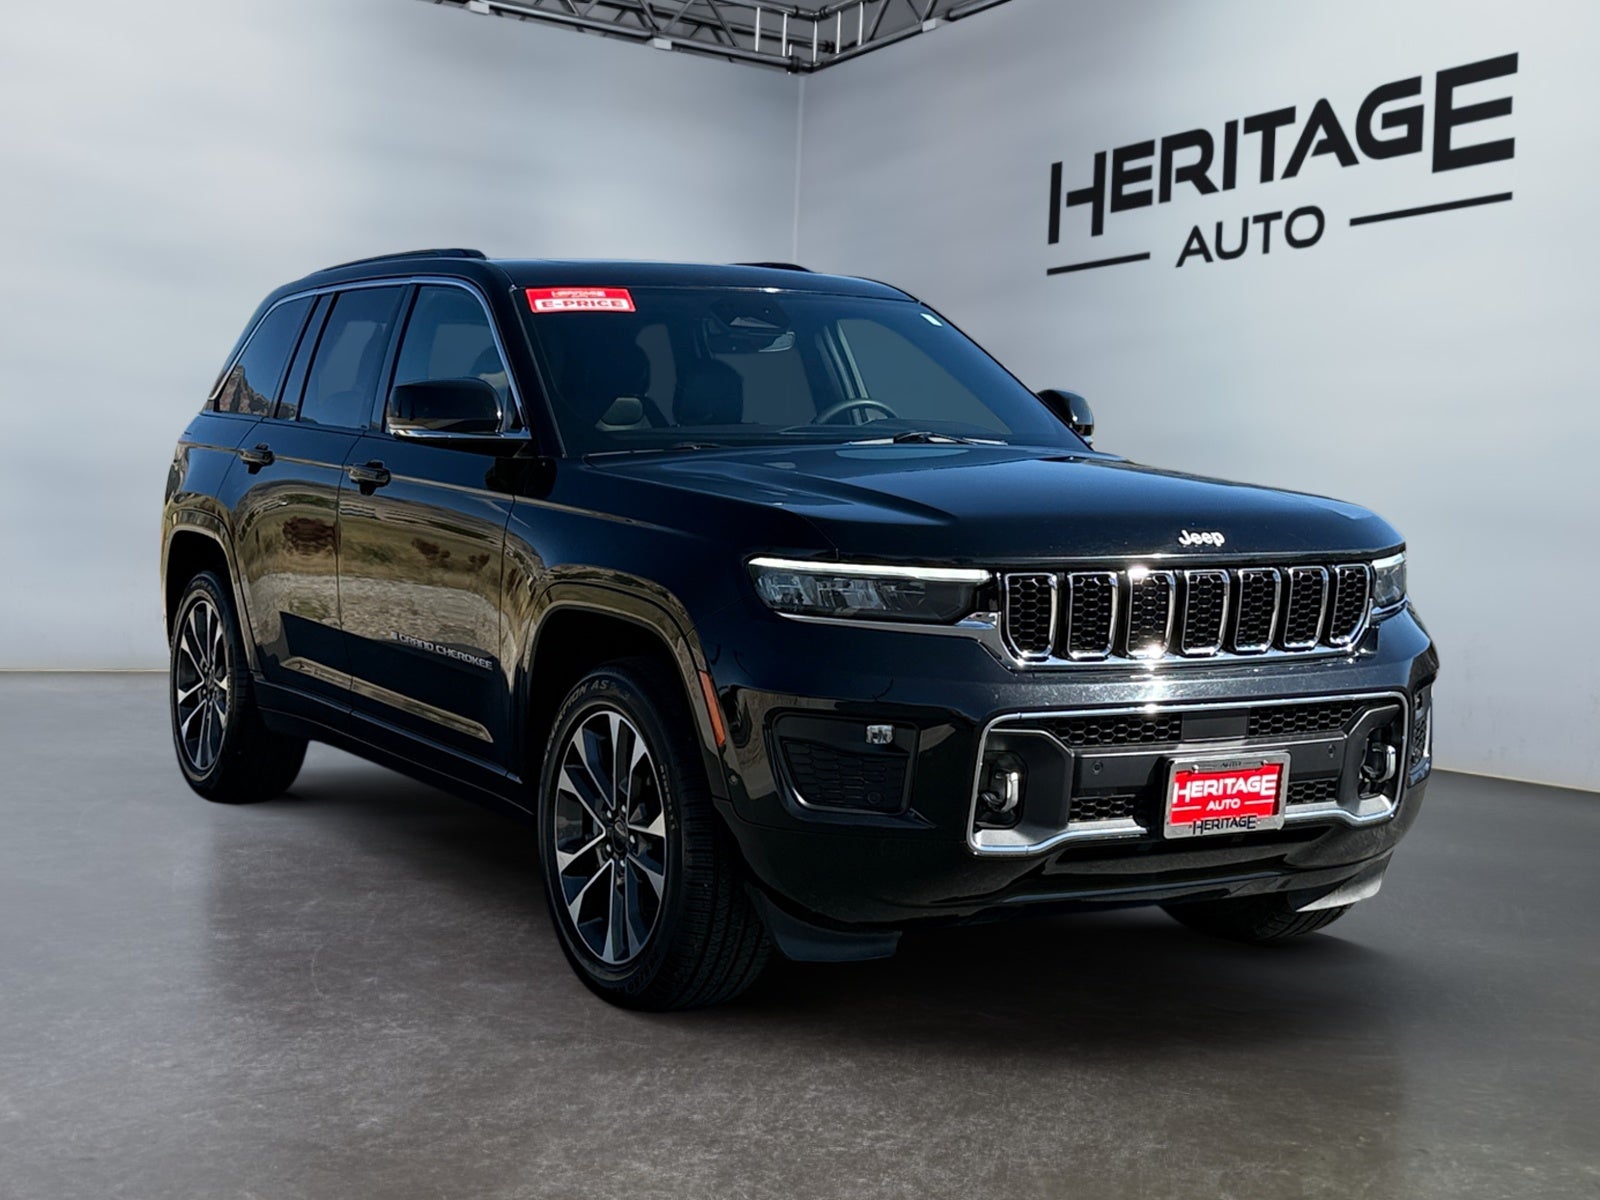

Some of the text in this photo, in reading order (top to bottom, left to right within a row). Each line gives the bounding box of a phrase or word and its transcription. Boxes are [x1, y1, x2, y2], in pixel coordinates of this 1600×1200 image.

[1048, 53, 1519, 244] HERITAGE
[1176, 206, 1324, 268] AUTO
[540, 299, 624, 308] E-PRICE
[1178, 529, 1226, 548] Jeep
[435, 644, 494, 671] CHEROKEE
[1172, 774, 1279, 804] HERITAGE
[1205, 798, 1242, 812] AUTO
[1191, 814, 1258, 836] HERITAGE
